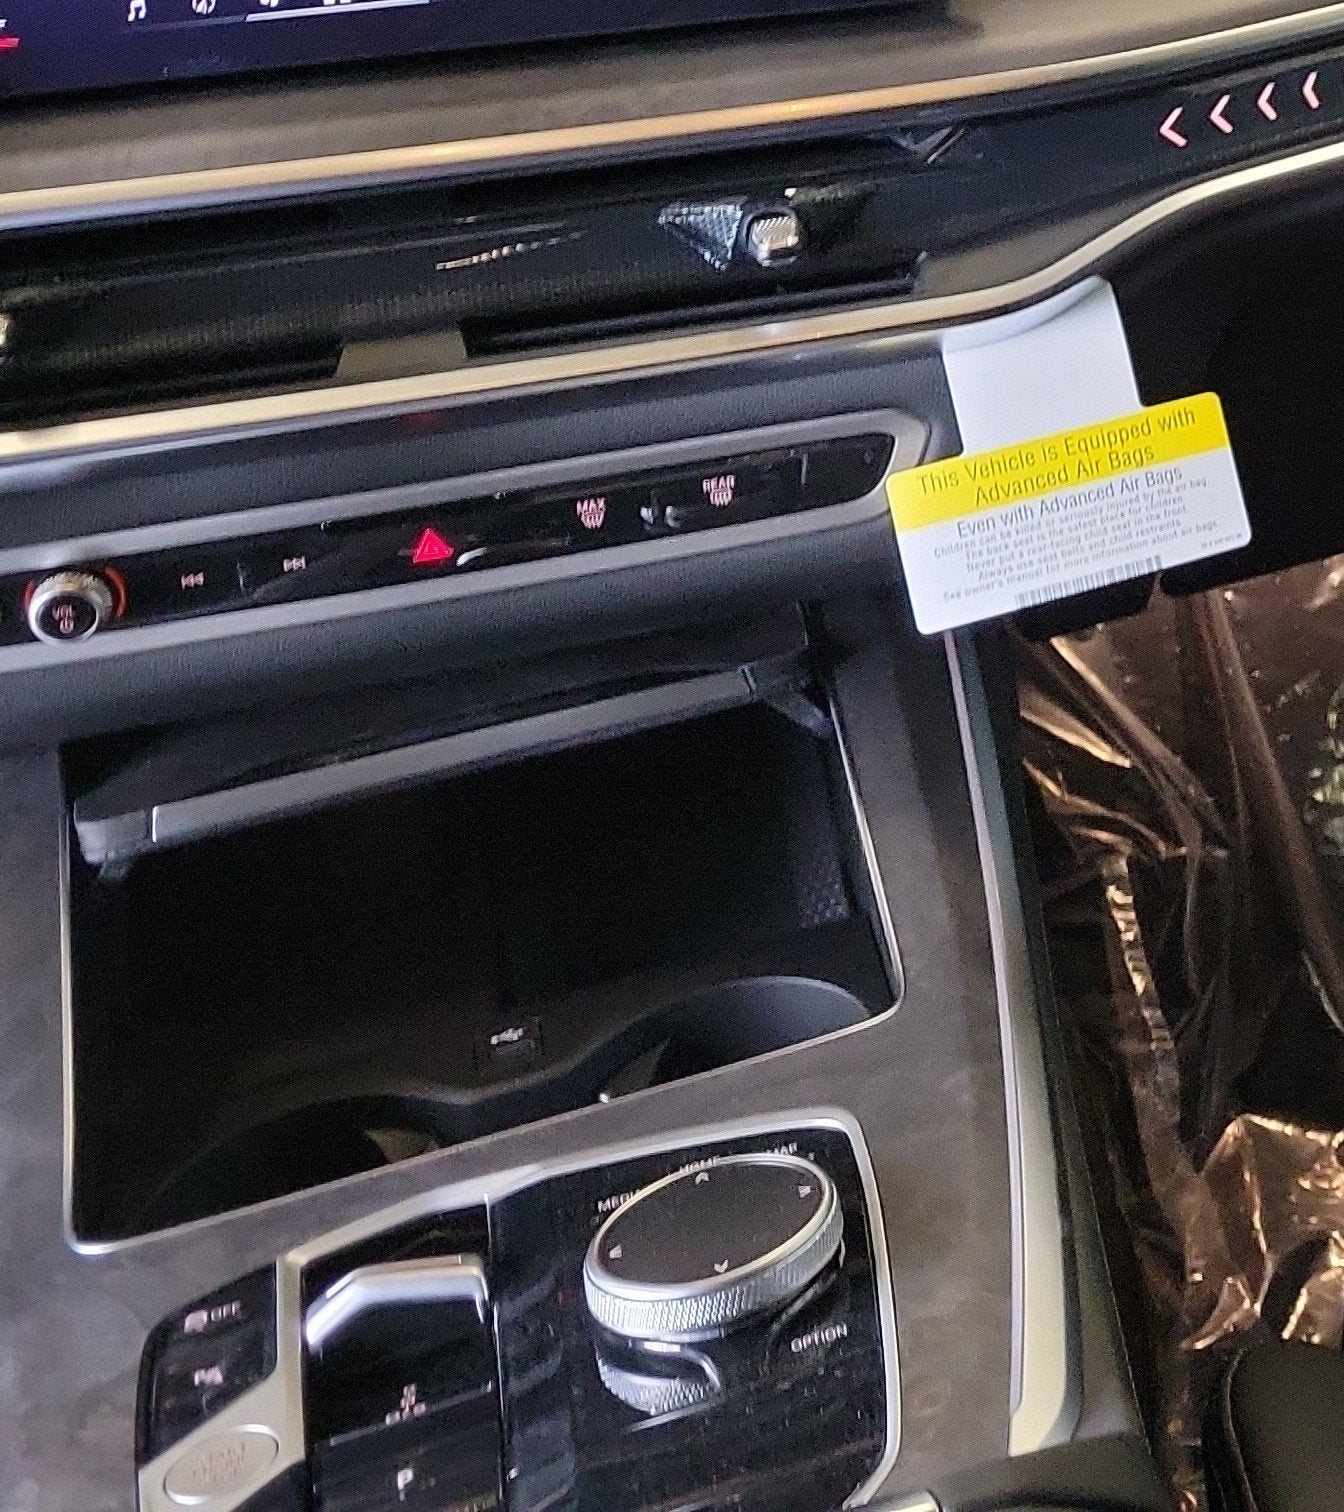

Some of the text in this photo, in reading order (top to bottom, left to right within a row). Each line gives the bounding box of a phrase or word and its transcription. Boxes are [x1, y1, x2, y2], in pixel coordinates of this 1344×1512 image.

[917, 407, 1197, 497] This Vehicle is Equipped with
[975, 444, 1155, 507] Advanced Air Bags
[576, 496, 606, 517] MAX
[934, 539, 975, 559] Children
[980, 533, 997, 545] can
[1001, 527, 1012, 540] be
[1015, 521, 1042, 536] killed
[1106, 495, 1140, 513] injured
[1157, 487, 1173, 499] the
[1175, 482, 1187, 493] air
[957, 467, 1182, 539] Even with Advanced Air Bags
[966, 548, 984, 561] The
[987, 543, 1009, 557] back
[1013, 536, 1034, 550] seat
[1048, 527, 1064, 539] the
[1068, 519, 1097, 535] safest
[1128, 506, 1142, 517] for
[943, 590, 961, 602] See
[1006, 569, 1043, 583] manual
[1046, 564, 1060, 576] for
[1064, 558, 1088, 570] more
[1092, 541, 1148, 562] information
[1151, 530, 1178, 546] about
[1181, 526, 1192, 537] air
[966, 559, 995, 573] Never
[999, 553, 1015, 567] put
[1084, 524, 1108, 539] child
[1112, 520, 1131, 533] seat
[1134, 517, 1143, 529] in
[1145, 512, 1161, 525] the
[978, 563, 1014, 582] Always
[1017, 558, 1033, 569] use
[1037, 551, 1058, 566] seat
[1088, 537, 1106, 550] and
[1109, 530, 1132, 544] child
[790, 1323, 849, 1353] OPTION
